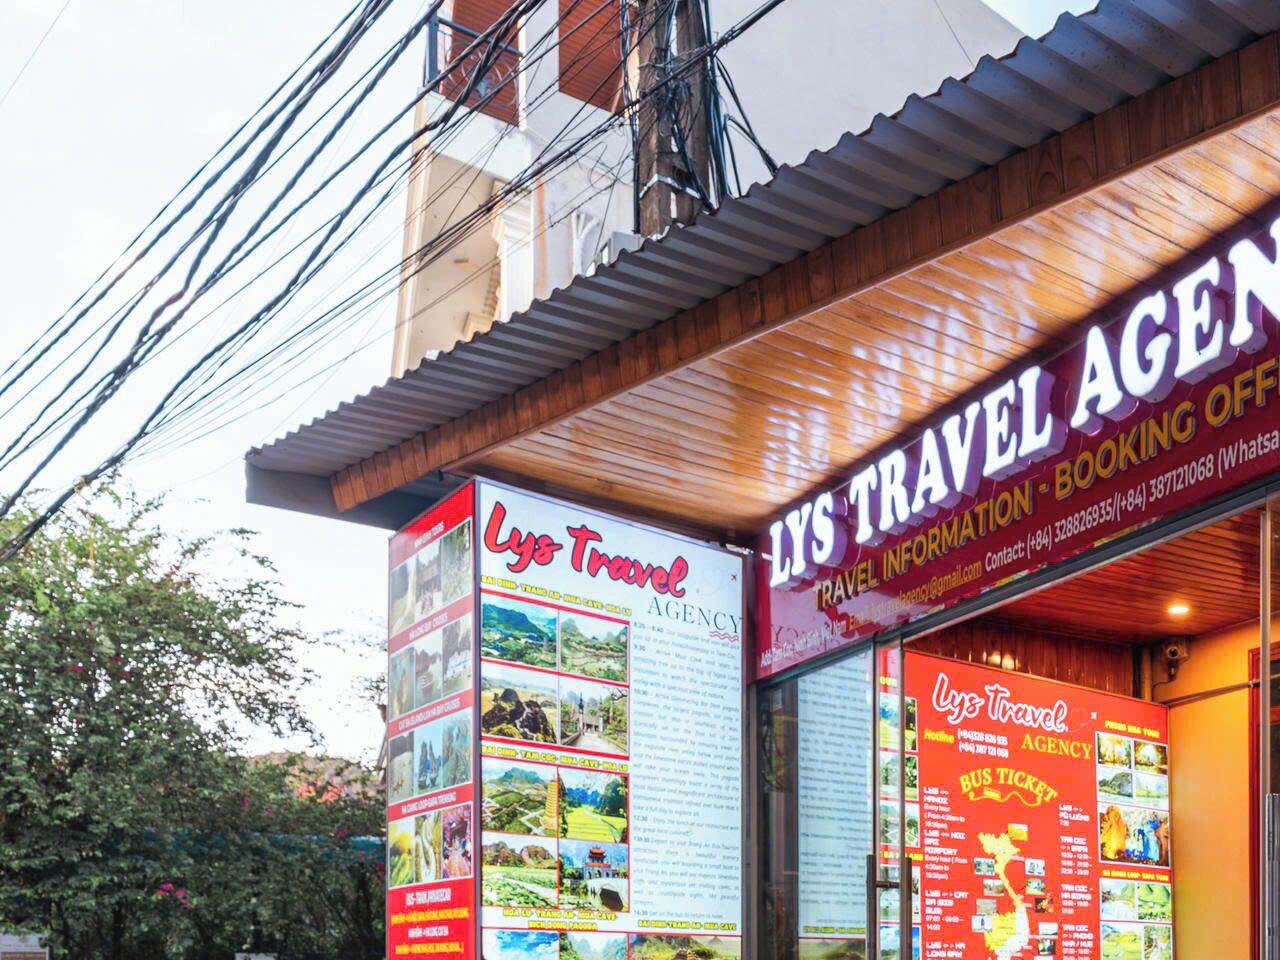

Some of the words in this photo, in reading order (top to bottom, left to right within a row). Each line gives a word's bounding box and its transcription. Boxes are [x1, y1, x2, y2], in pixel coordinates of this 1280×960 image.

[769, 491, 836, 588] LYS
[849, 365, 1053, 545] TRAVEL
[814, 559, 880, 612] TRAVEL
[882, 479, 1034, 582] INFORMATION
[1054, 400, 1196, 501] BOOKING
[984, 538, 1026, 573] Contact:
[1026, 523, 1053, 560] (+84)
[1149, 453, 1215, 503] 387121068
[484, 501, 563, 573] Lys
[566, 525, 689, 599] Travel
[647, 596, 744, 635] AGENCY
[932, 672, 985, 725] Lys
[984, 683, 1068, 733] Travel
[924, 728, 955, 744] Hotline
[1021, 733, 1093, 760] AGENCY
[959, 768, 993, 795] BUS
[996, 767, 1058, 803] TICKET
